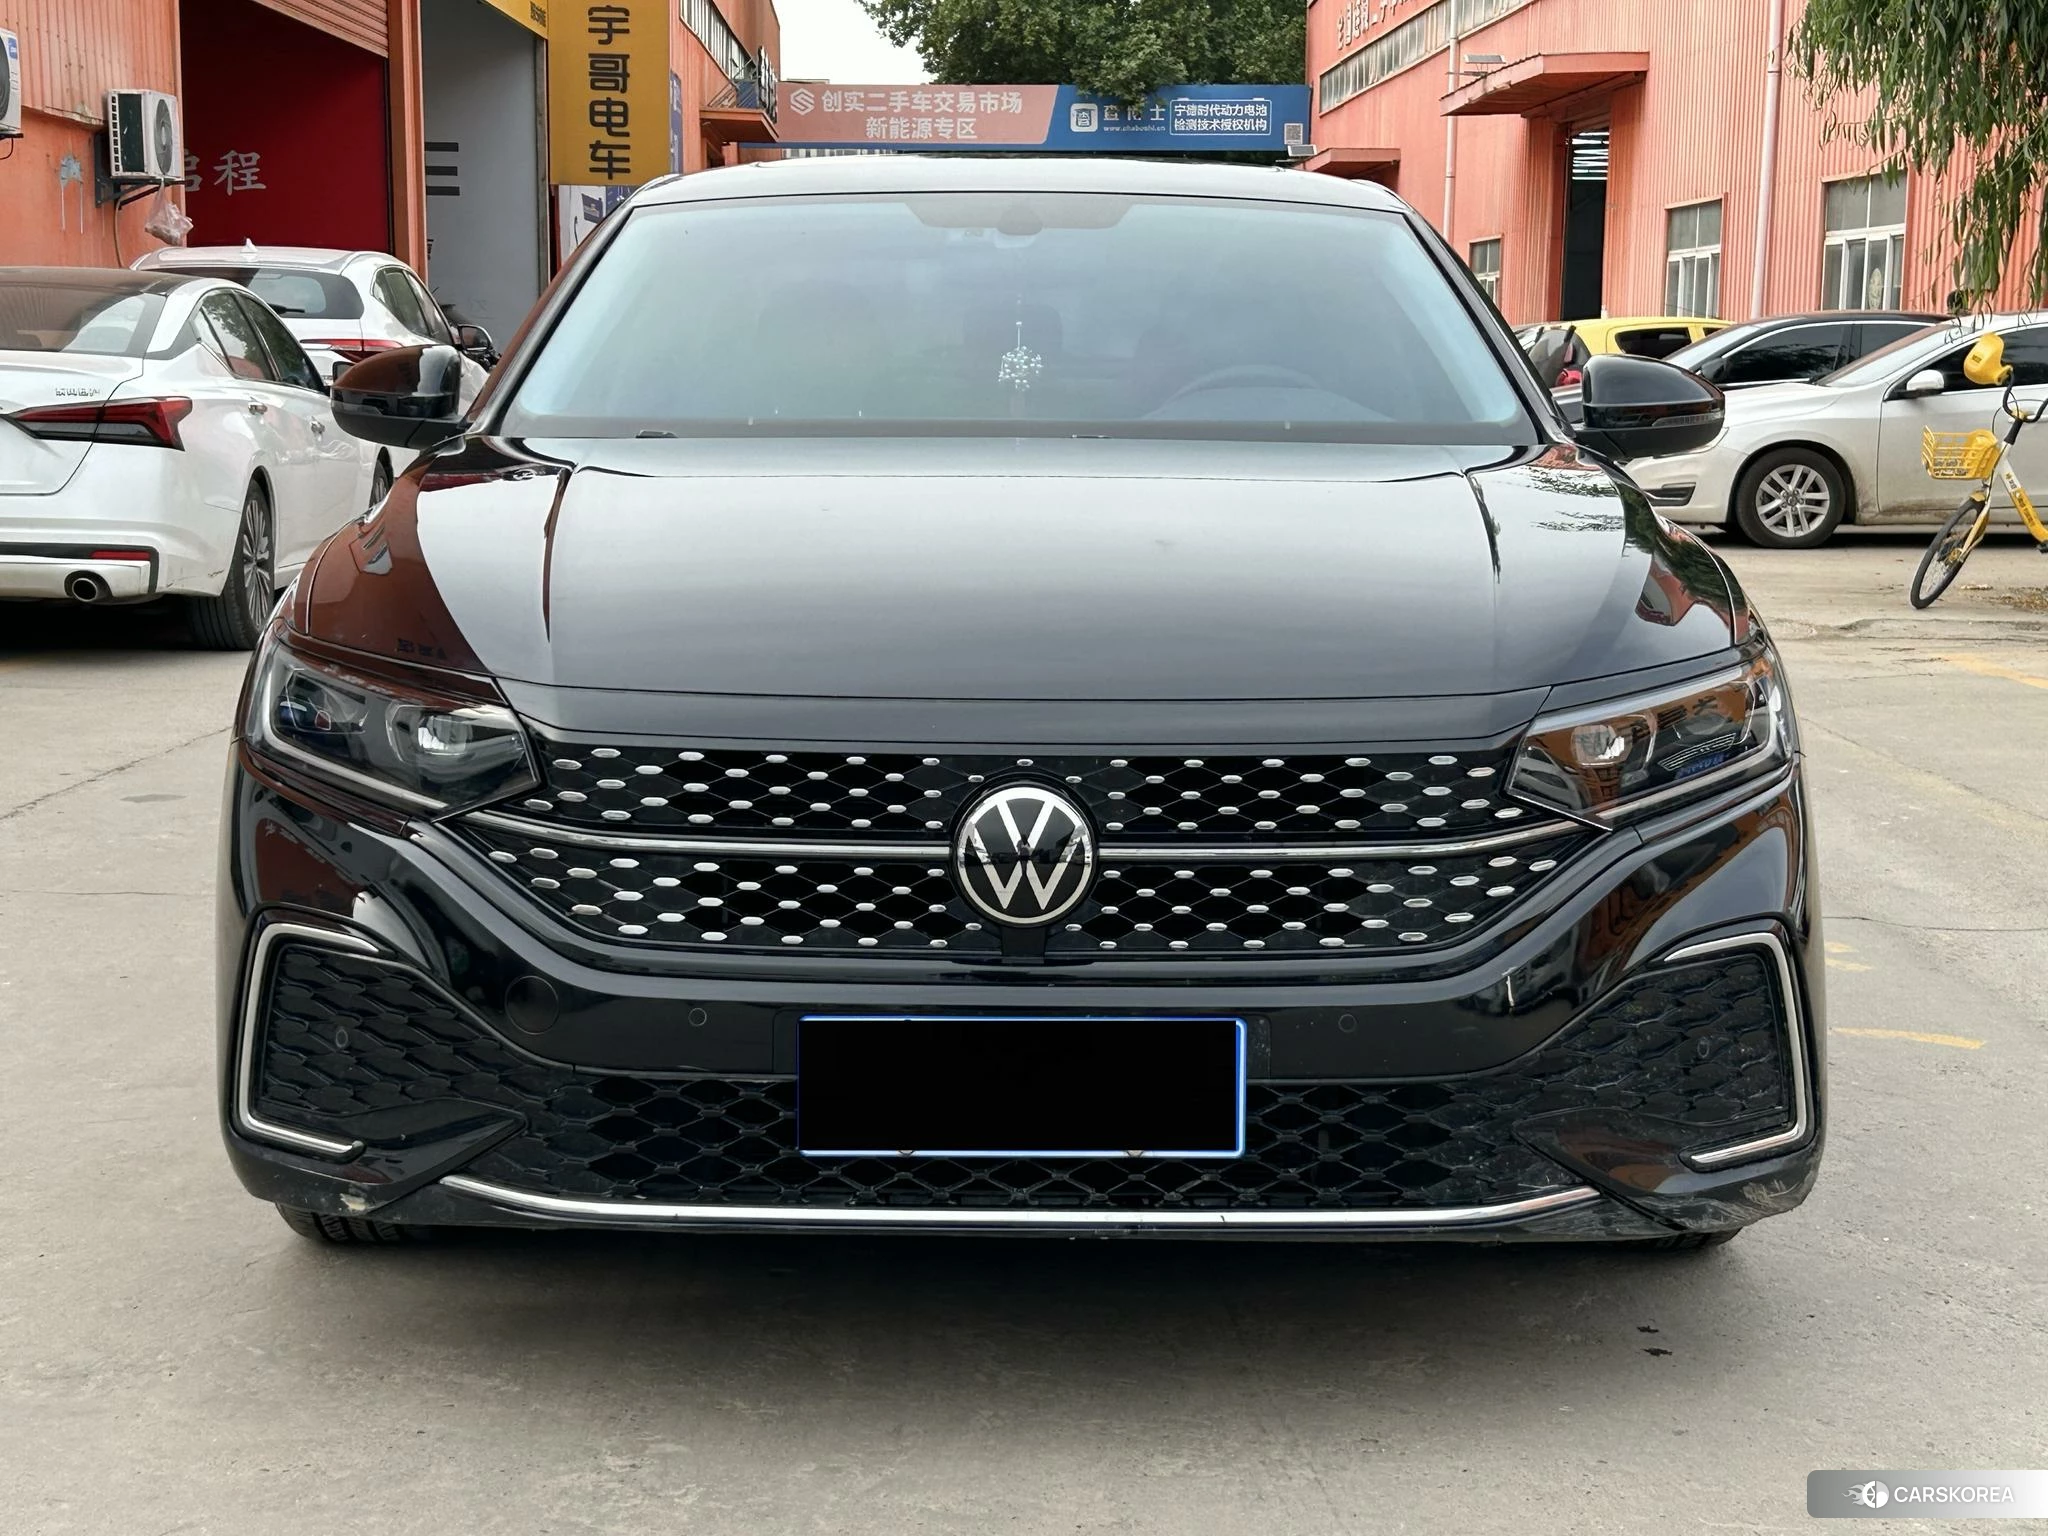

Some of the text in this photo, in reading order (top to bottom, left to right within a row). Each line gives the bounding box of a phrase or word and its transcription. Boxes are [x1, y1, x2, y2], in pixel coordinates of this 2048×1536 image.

[588, 5, 631, 181] 宇哥电车
[821, 91, 1023, 114] 创实二手车交易市场
[1174, 104, 1268, 117] 宁德时代动力电池
[866, 117, 977, 139] 新能源专区
[1174, 118, 1268, 131] 检测技术授权机构
